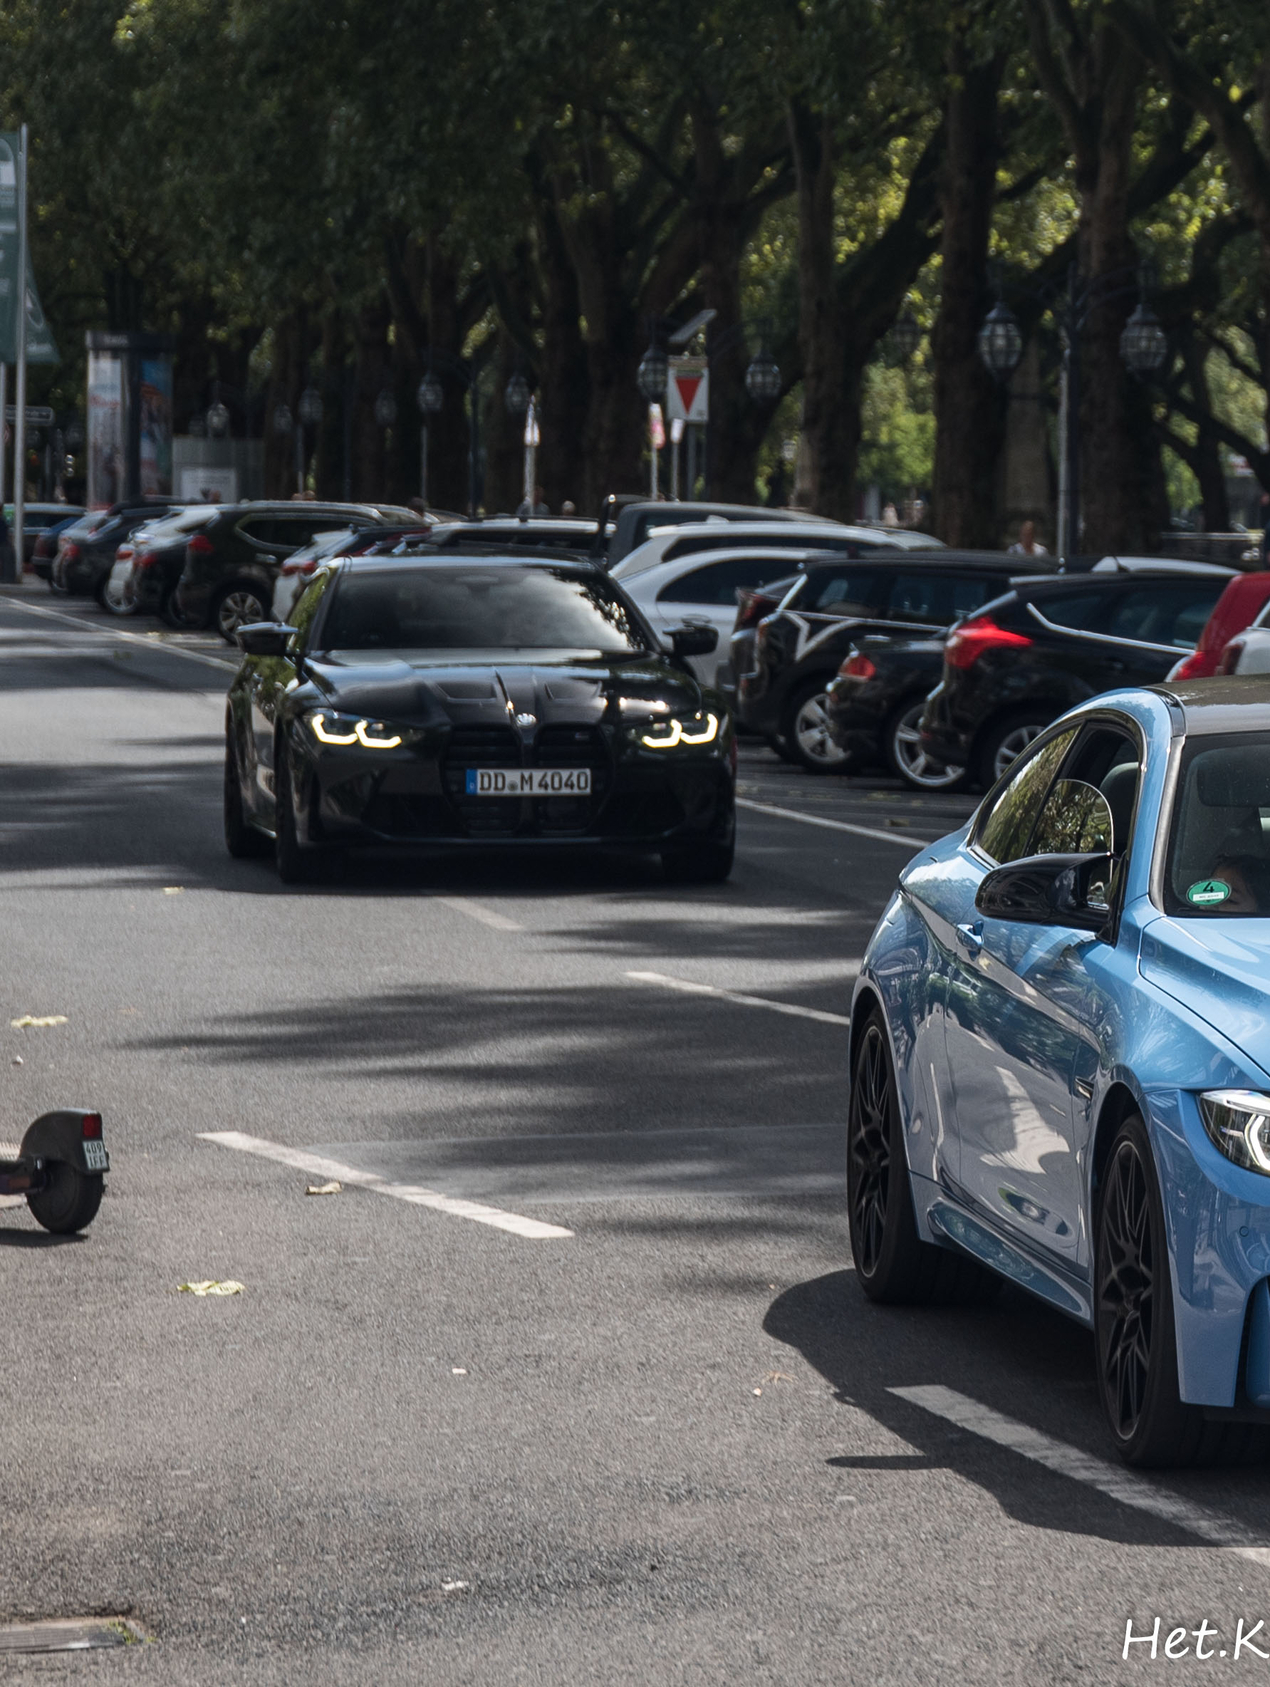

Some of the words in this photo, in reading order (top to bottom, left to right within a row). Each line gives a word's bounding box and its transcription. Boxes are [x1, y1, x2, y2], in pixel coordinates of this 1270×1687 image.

[479, 771, 506, 791] DD
[520, 771, 533, 791] M
[538, 771, 588, 791] 4040
[1203, 881, 1215, 893] 4
